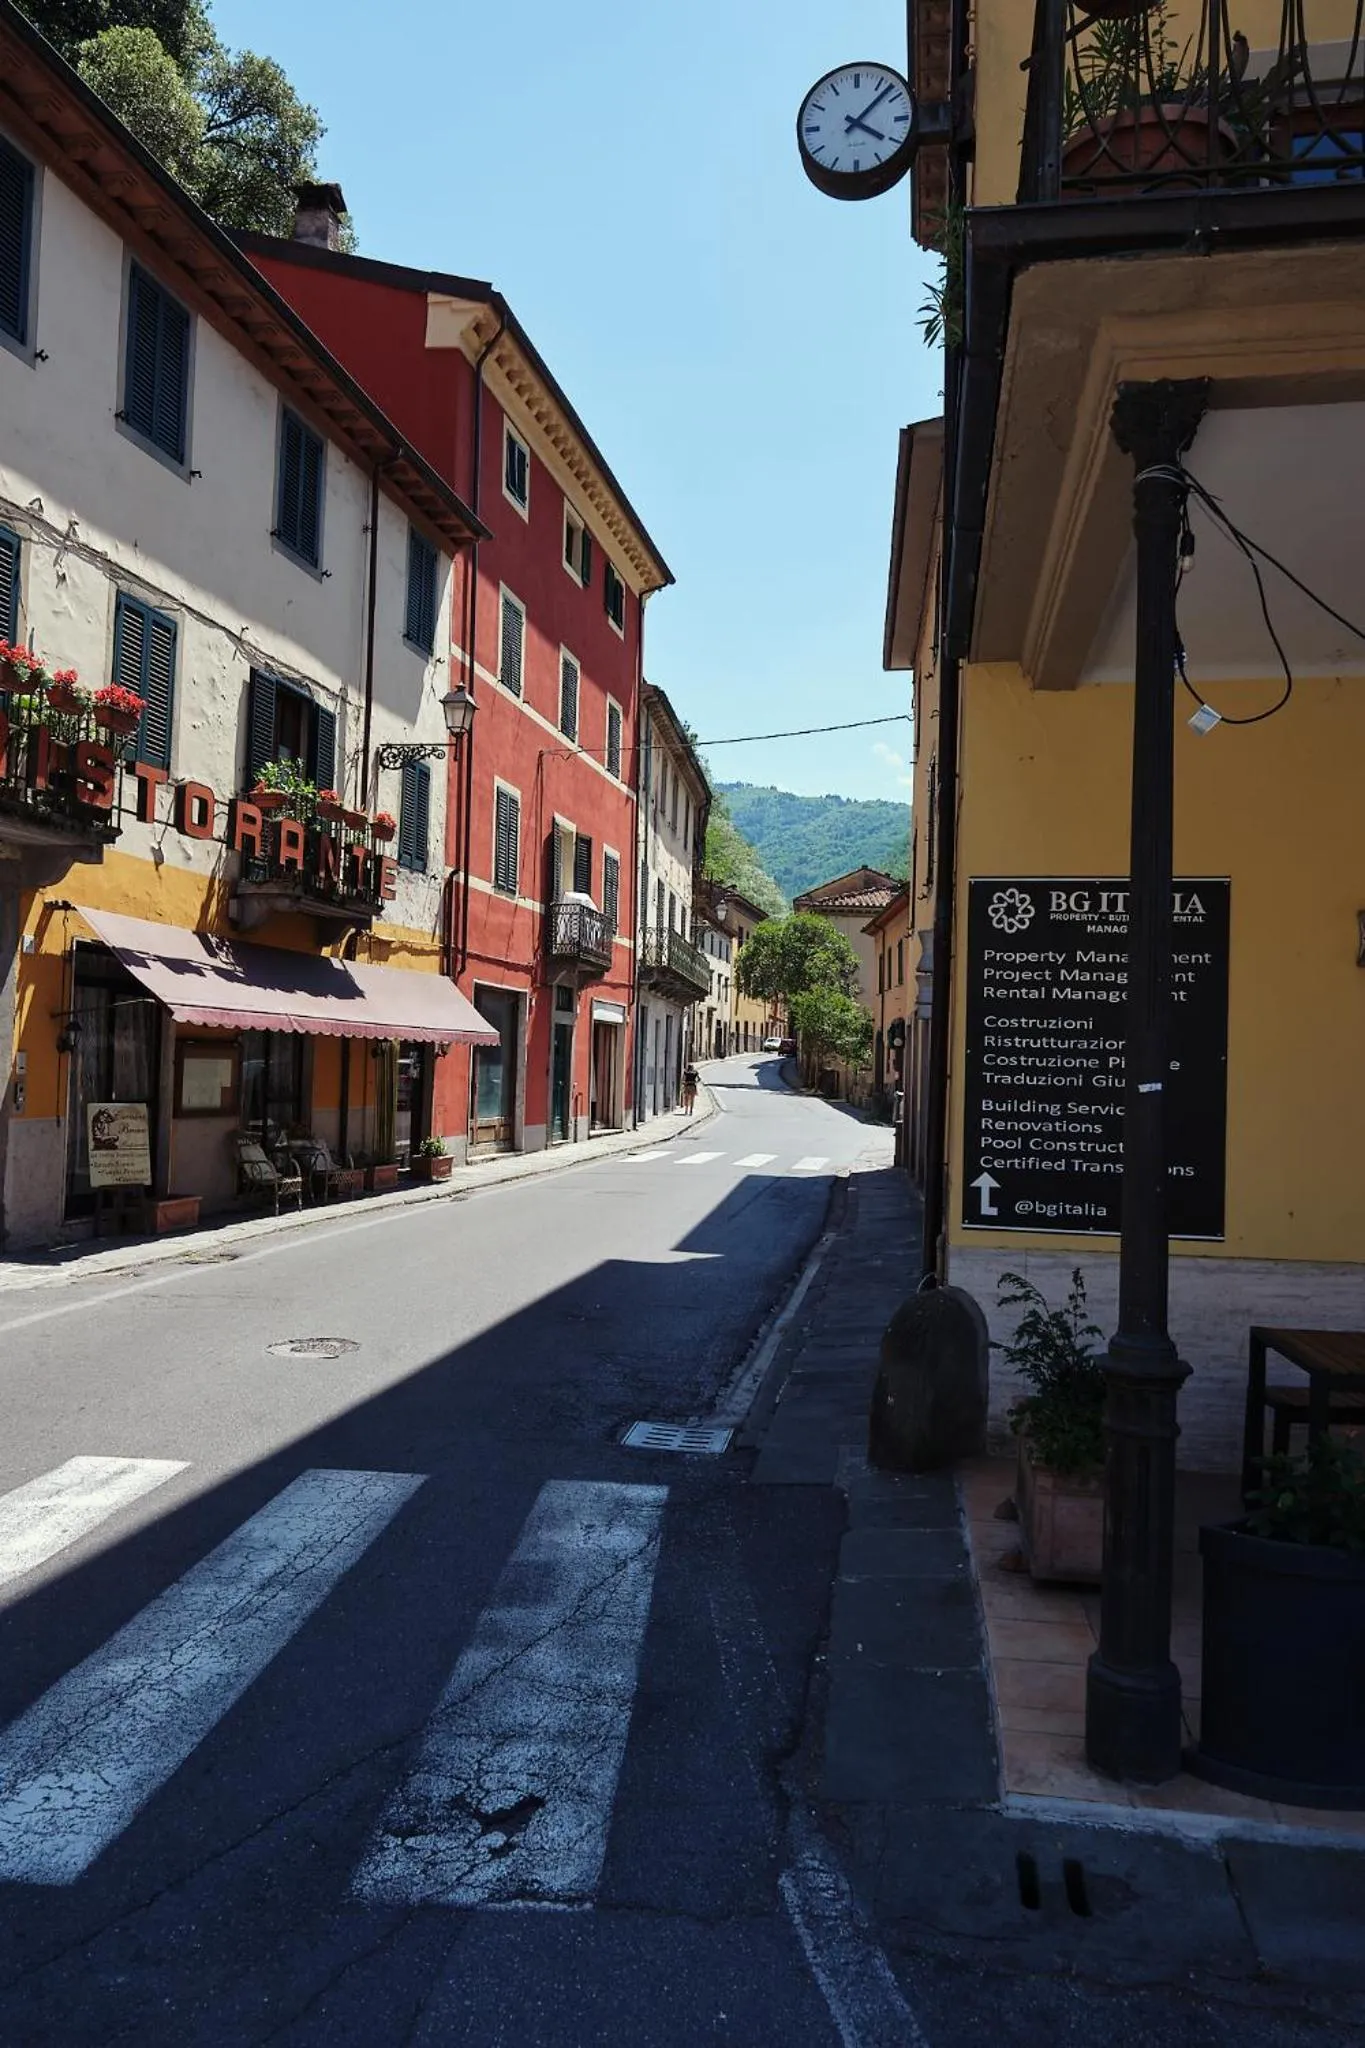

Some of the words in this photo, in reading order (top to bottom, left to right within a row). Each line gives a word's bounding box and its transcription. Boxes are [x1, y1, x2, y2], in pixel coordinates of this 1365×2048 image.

[0, 711, 399, 900] ISTORANTE
[1049, 891, 1091, 913] BG
[1097, 892, 1207, 915] ITIA
[1050, 913, 1099, 922] PROPERTY
[1172, 915, 1206, 924] ENTAL
[984, 949, 1066, 965] Property
[983, 967, 1052, 983] Project
[983, 986, 1045, 999] Rental
[983, 1015, 1093, 1030] Costruzioni
[983, 1053, 1100, 1069] Costruzione
[982, 1071, 1083, 1086] Traduzioni
[981, 1099, 1061, 1117] Building
[1067, 1102, 1125, 1116] Servic
[981, 1117, 1103, 1134] Renovations
[980, 1136, 1022, 1149] Pool
[980, 1155, 1066, 1171] Certified
[1014, 1200, 1107, 1217] @bgitalia
